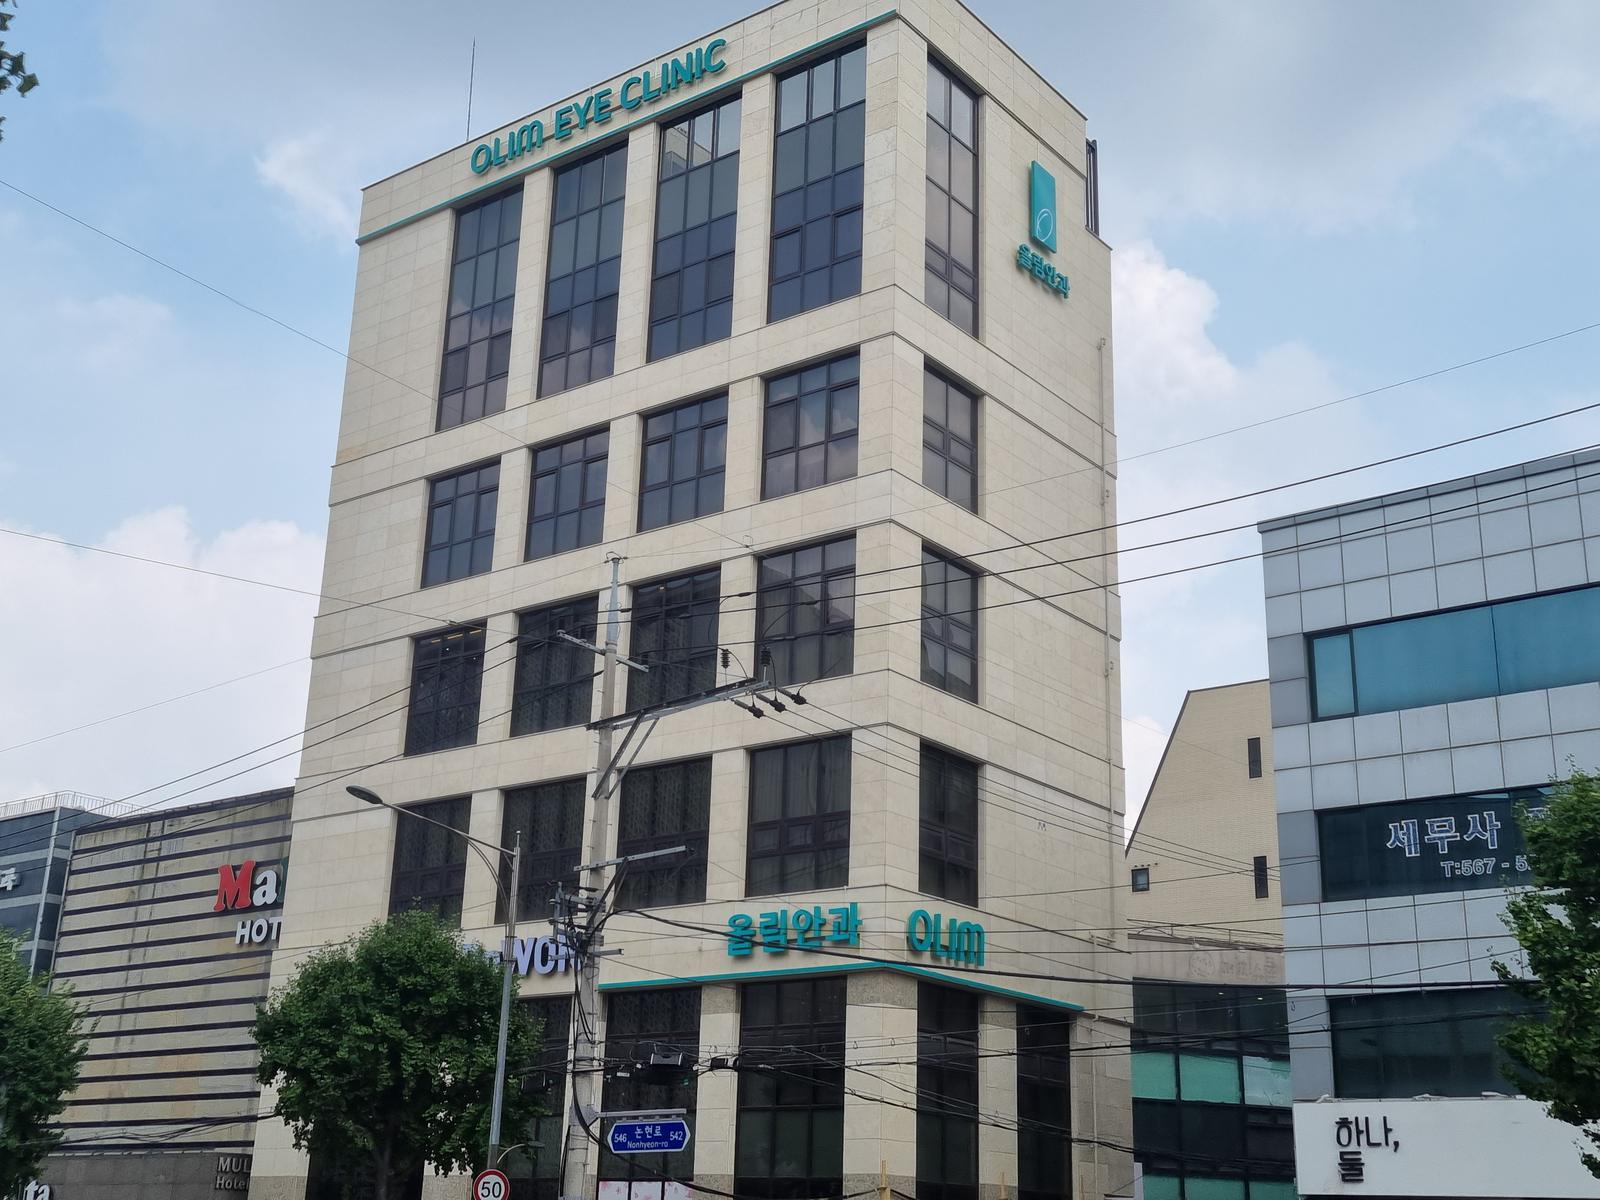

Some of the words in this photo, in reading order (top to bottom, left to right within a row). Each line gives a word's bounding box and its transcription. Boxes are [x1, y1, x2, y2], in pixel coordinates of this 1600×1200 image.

[470, 119, 544, 175] OLIM
[554, 87, 613, 140] EYE
[619, 38, 727, 111] CLINIC
[1017, 243, 1071, 299] 올림안과
[1386, 811, 1501, 857] 세무사
[1440, 857, 1496, 877] T:567
[727, 902, 864, 957] 올림안과
[907, 909, 986, 967] OLIM
[614, 1133, 628, 1143] 546
[635, 1125, 662, 1139] 논현로
[669, 1131, 684, 1141] 542
[627, 1141, 669, 1149] Nonhyeon-ro
[1335, 1116, 1400, 1152] 하나,
[1338, 1150, 1365, 1183] 둘
[480, 1181, 502, 1198] 50
